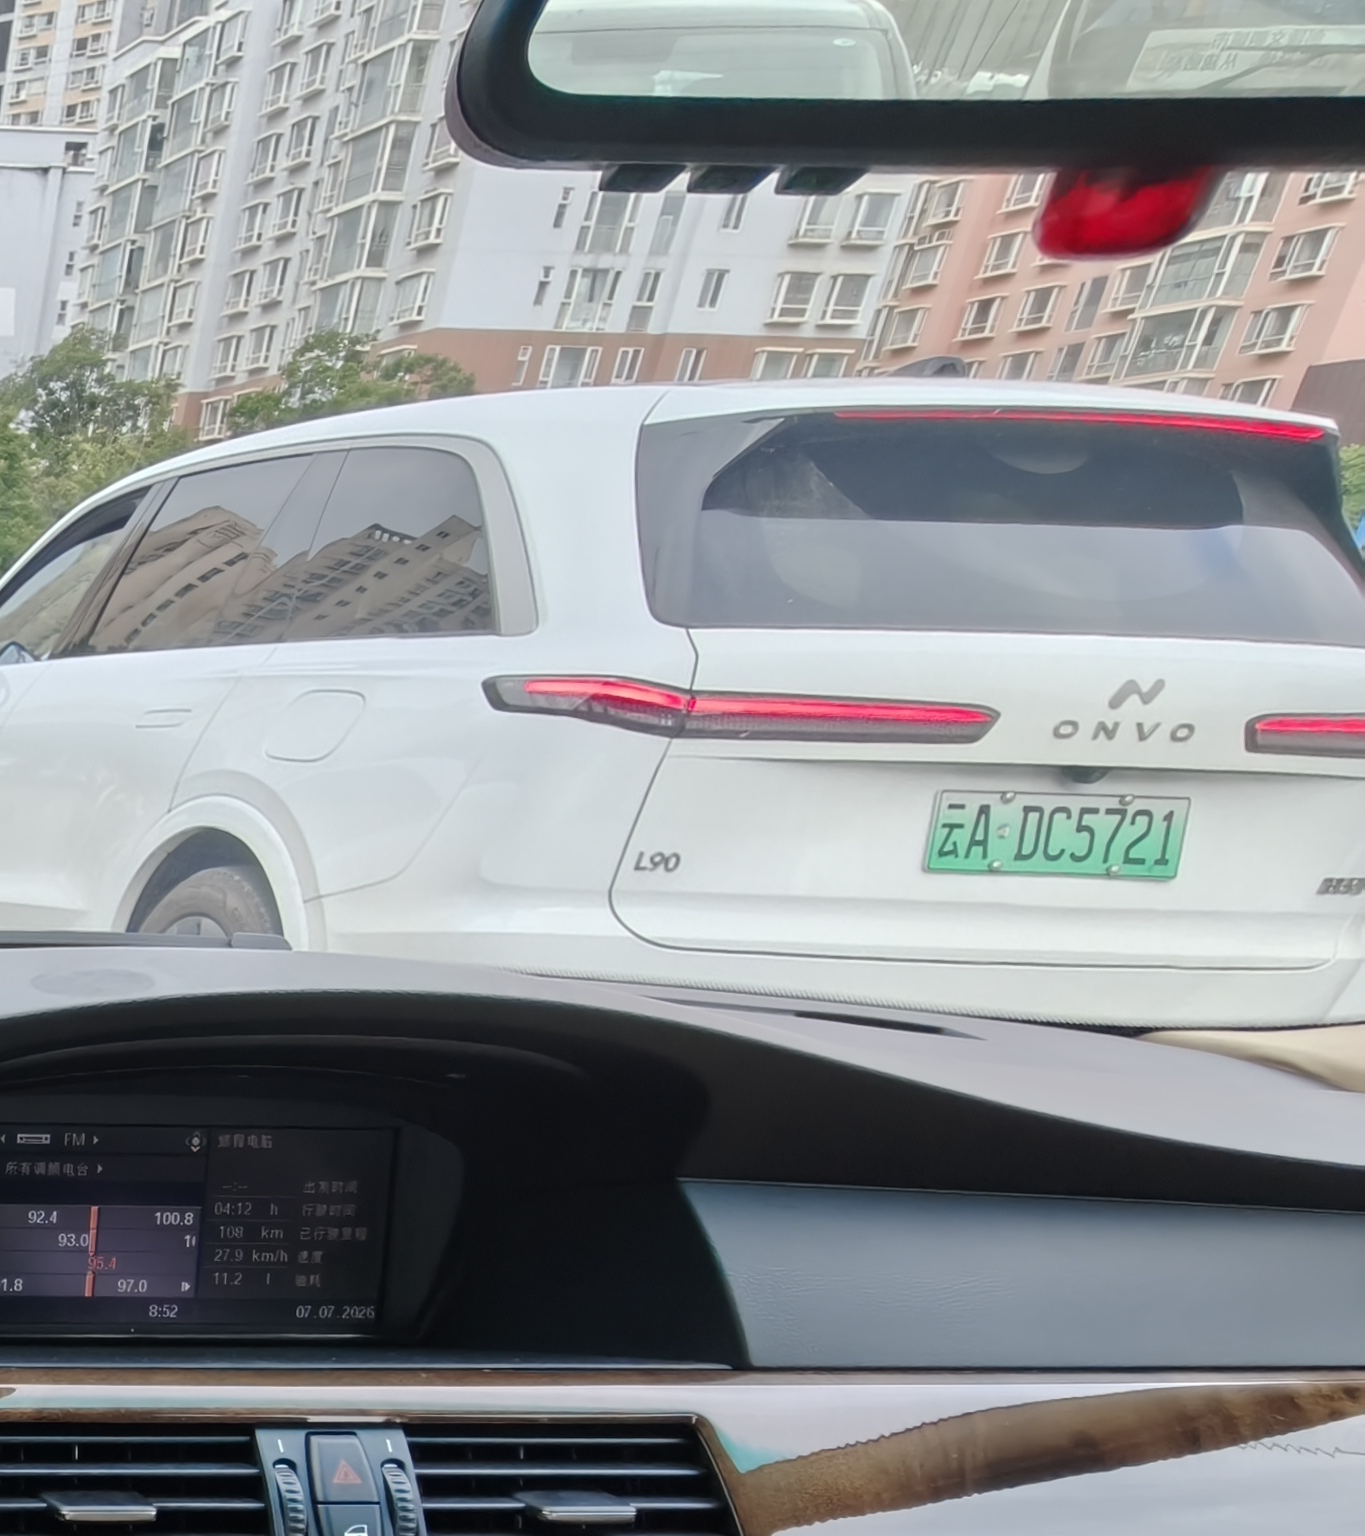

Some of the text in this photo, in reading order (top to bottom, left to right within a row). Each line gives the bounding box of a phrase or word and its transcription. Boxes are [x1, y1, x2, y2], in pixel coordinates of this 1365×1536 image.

[1053, 720, 1195, 743] ONVO
[634, 851, 681, 873] L90
[64, 1132, 86, 1146] FM
[214, 1201, 252, 1216] 04:12
[28, 1210, 57, 1224] 92.4
[154, 1212, 193, 1226] 100.8
[261, 1225, 284, 1239] km
[58, 1233, 89, 1247] 93.0
[214, 1248, 288, 1263] 27.9 km/h
[87, 1256, 116, 1270] 95.4
[117, 1279, 147, 1293] 97.0
[213, 1272, 243, 1286] 11.2
[149, 1304, 178, 1318] 8:52
